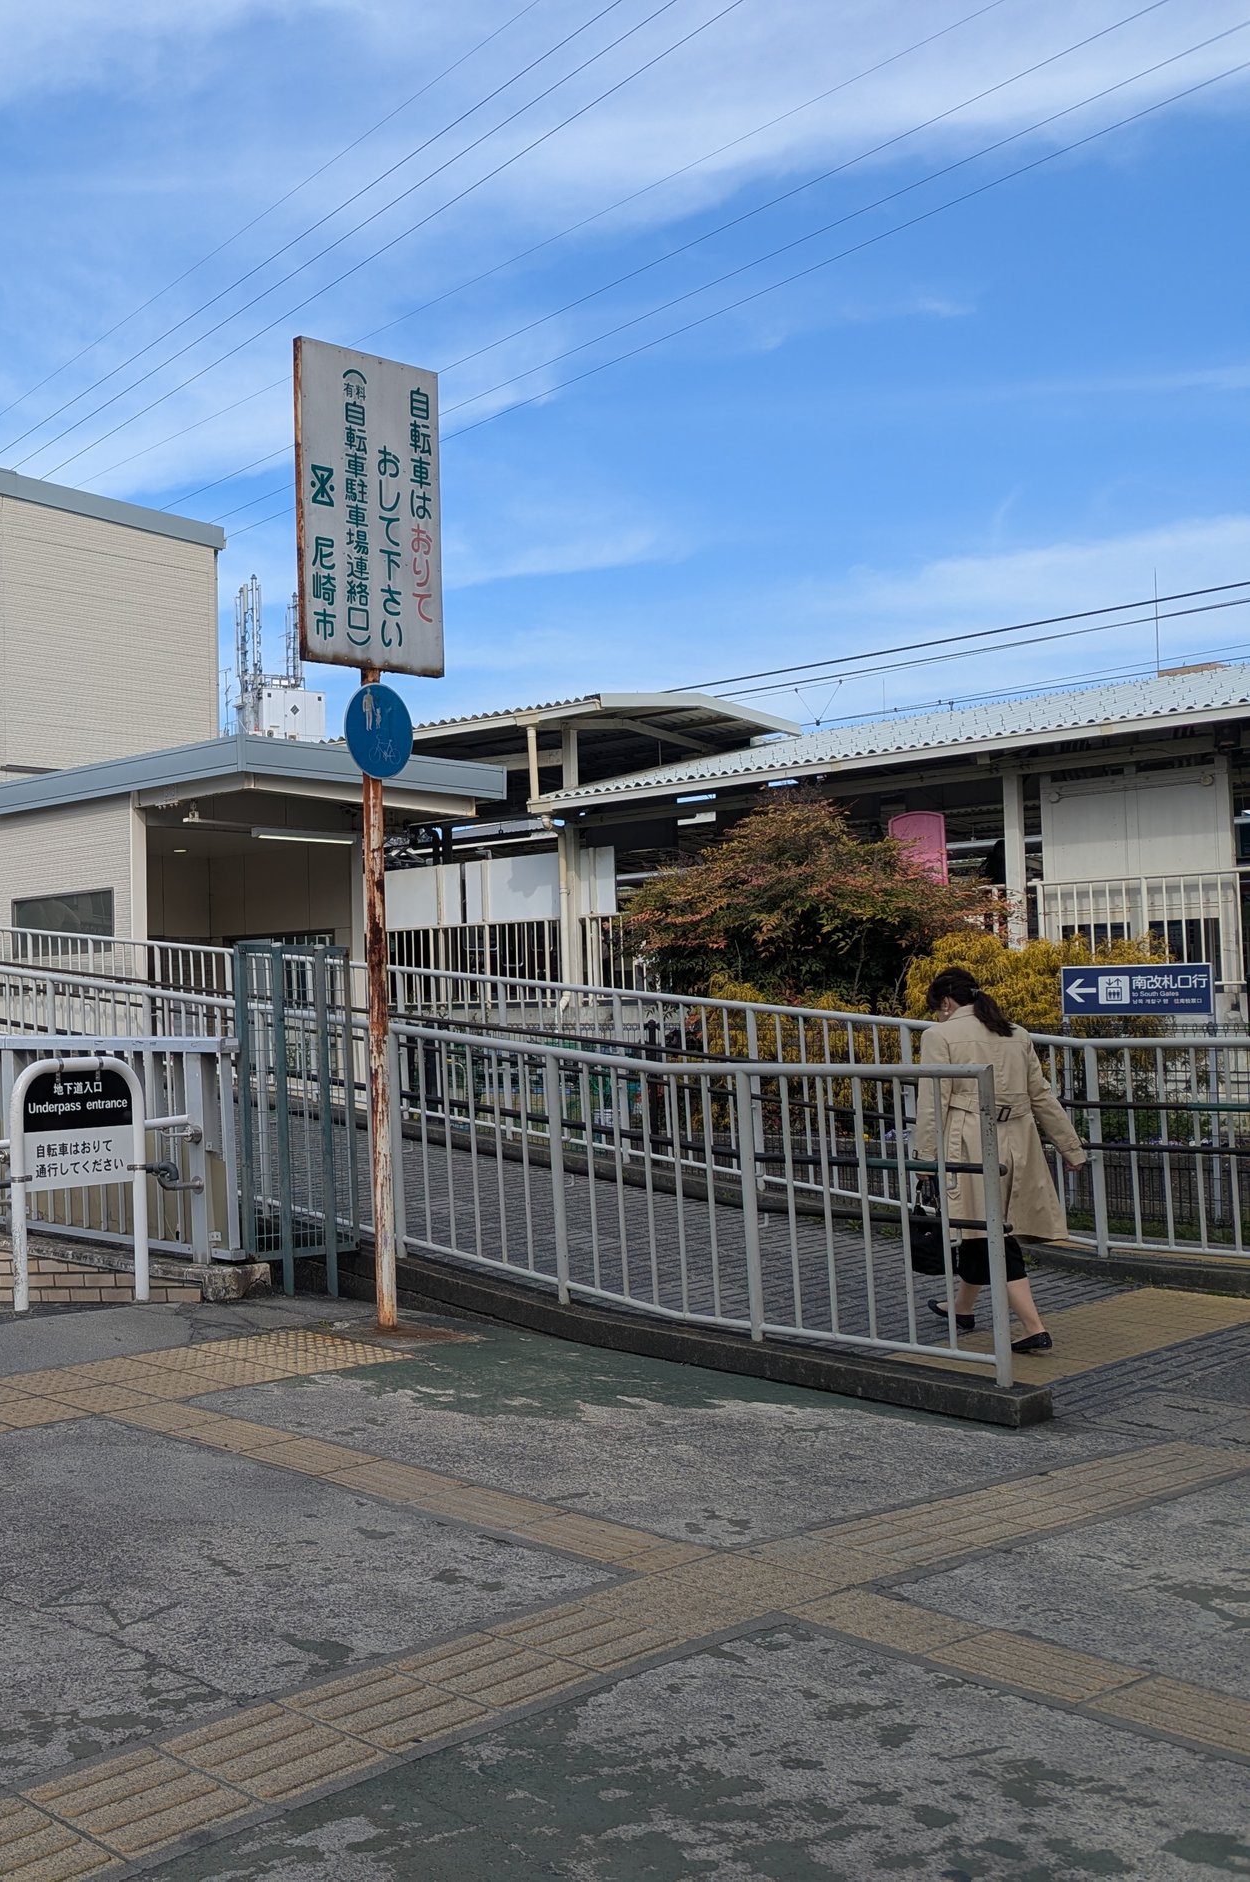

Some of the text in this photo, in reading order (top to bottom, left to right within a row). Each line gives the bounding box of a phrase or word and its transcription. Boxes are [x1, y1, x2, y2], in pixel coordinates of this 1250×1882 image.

[409, 387, 434, 623] 自転車はおりて
[377, 444, 403, 648] おして下さい
[312, 535, 337, 641] 尼崎市
[1131, 973, 1208, 990] 南改札口行
[53, 1081, 103, 1096] 地下道入口
[28, 1098, 128, 1115] Underpass entrance
[36, 1139, 113, 1159] 自転車はおりて
[35, 1158, 124, 1179] 通行してください
